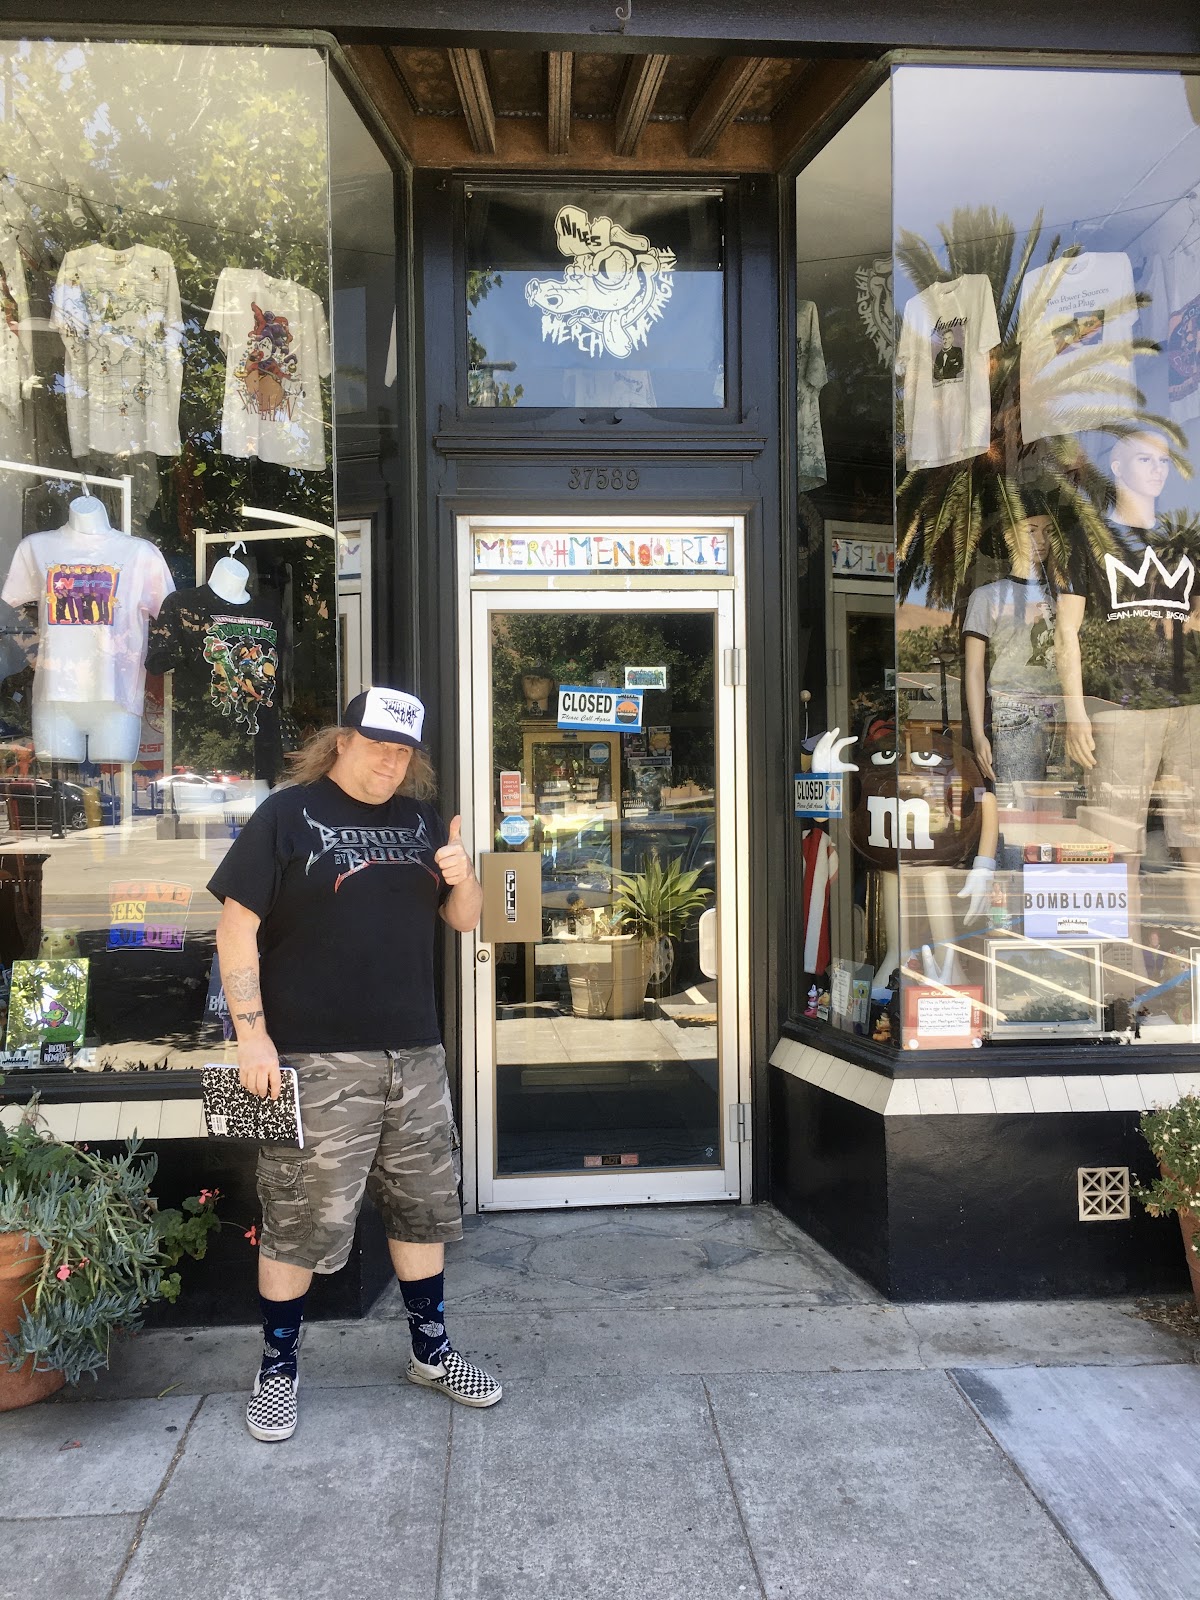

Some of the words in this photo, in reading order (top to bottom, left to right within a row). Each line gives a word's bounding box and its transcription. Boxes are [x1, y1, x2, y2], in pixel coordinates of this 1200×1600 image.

[560, 214, 601, 247] NILES
[1060, 293, 1080, 303] Power
[1081, 287, 1109, 298] Sources
[1058, 303, 1072, 312] and
[541, 314, 604, 358] MERCH
[568, 468, 640, 491] 37589
[1106, 609, 1163, 622] JEAN-MICHEL
[562, 692, 612, 714] CLOSED
[561, 713, 579, 721] Please
[580, 714, 593, 722] Call
[796, 781, 824, 800] CLOSED
[867, 795, 935, 850] m
[506, 874, 515, 910] PULL
[1024, 892, 1127, 909] BOMBLOADS
